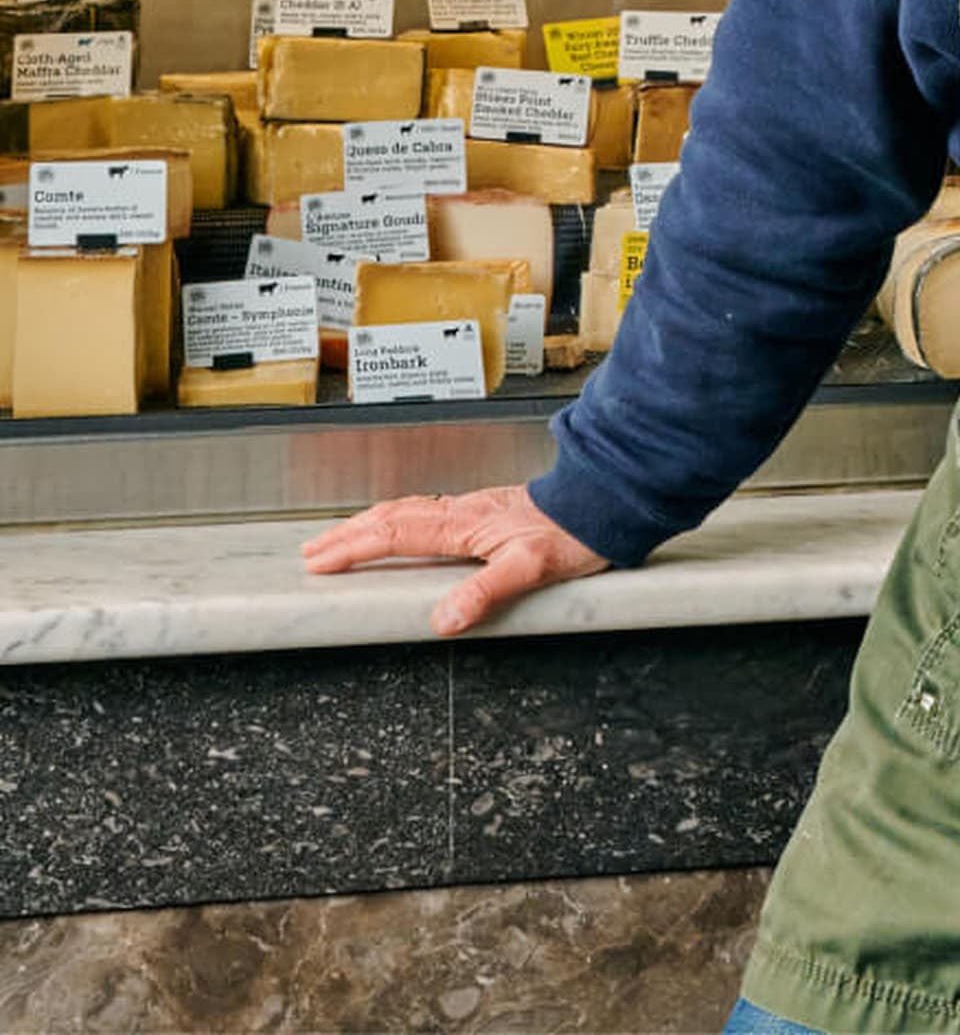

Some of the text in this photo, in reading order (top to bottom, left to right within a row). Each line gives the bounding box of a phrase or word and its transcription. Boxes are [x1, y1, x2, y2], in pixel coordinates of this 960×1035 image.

[625, 34, 712, 47] Truffle Ched
[347, 145, 389, 158] Queso
[391, 142, 409, 154] de
[306, 218, 380, 235] Signature
[241, 306, 314, 322] Symphonie
[355, 354, 428, 373] Ironbark
